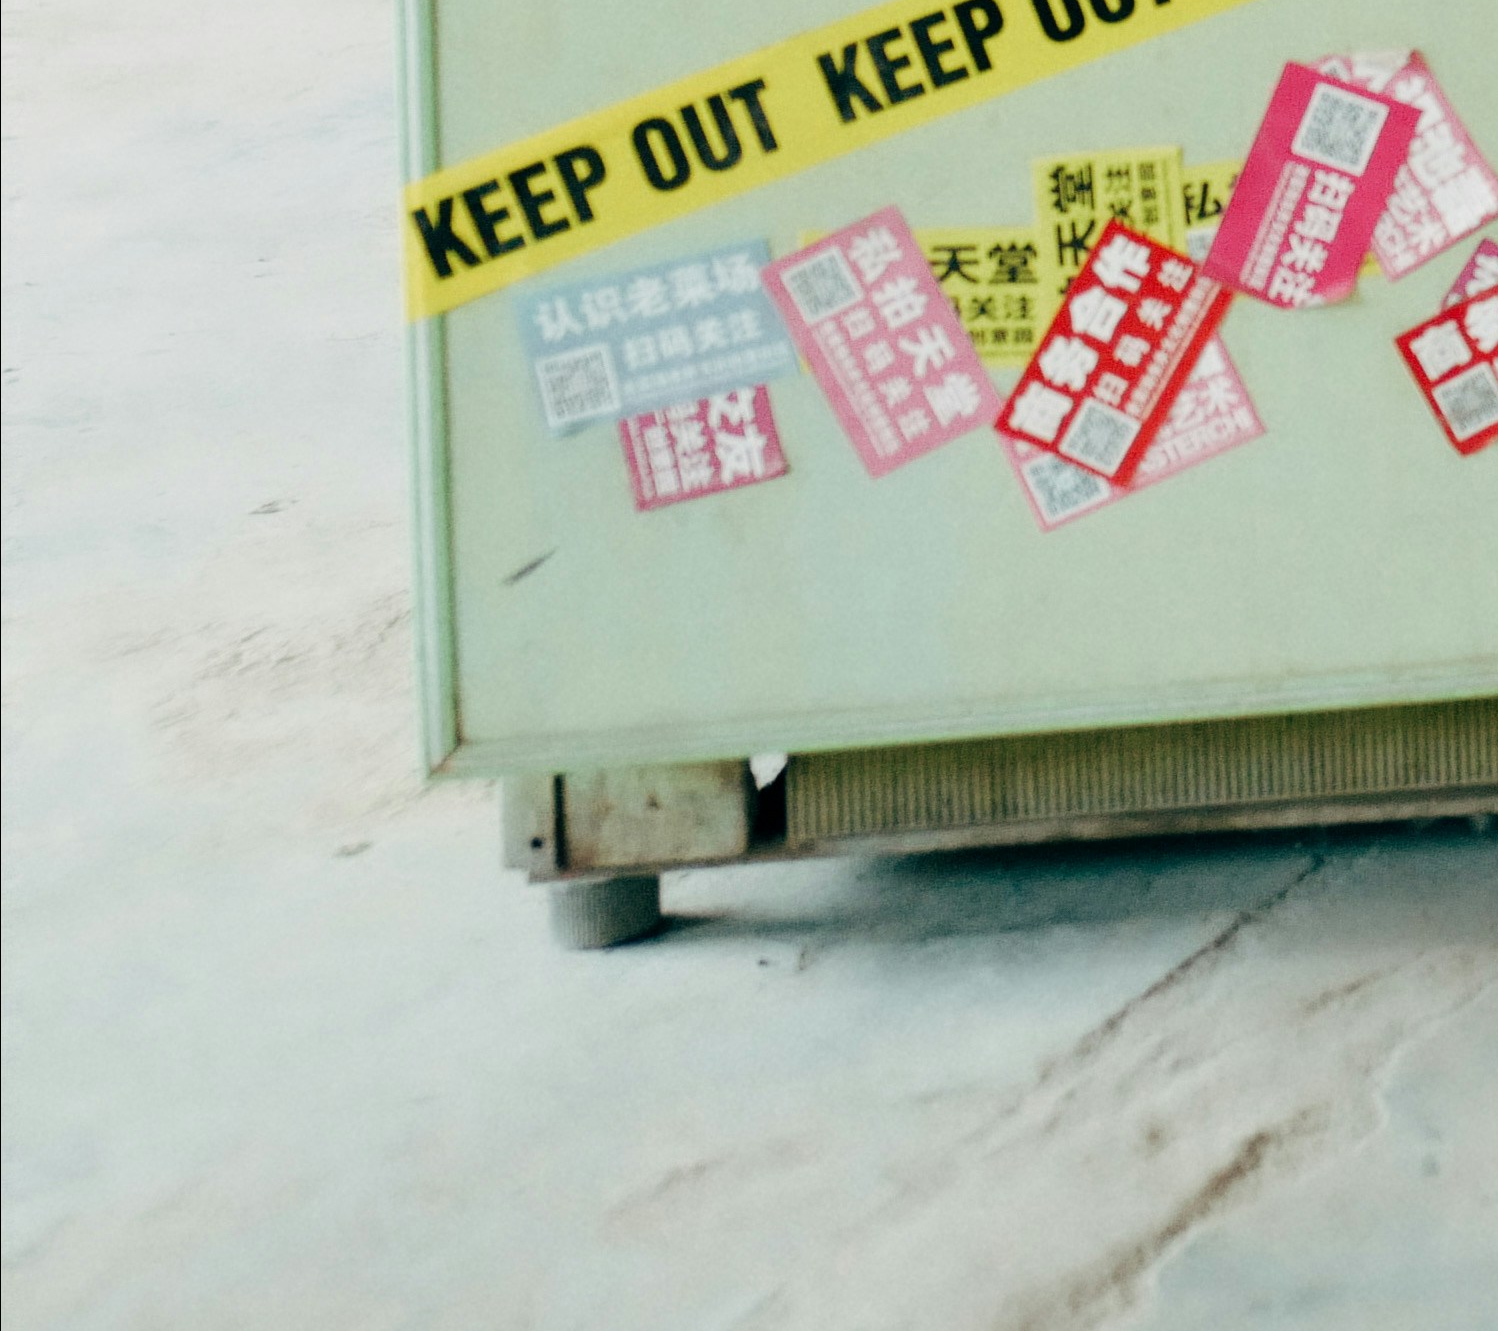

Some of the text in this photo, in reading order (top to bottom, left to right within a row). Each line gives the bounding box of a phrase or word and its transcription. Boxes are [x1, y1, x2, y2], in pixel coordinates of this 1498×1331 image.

[413, 142, 608, 280] KEEP
[627, 77, 780, 195] OUT
[1049, 161, 1096, 266] 天堂
[1266, 168, 1355, 308] 扫码关注
[847, 225, 983, 428] 私拍天堂
[929, 240, 1039, 286] 天堂
[1097, 258, 1196, 404] 扫码关注
[621, 309, 763, 372] 扫码关注
[838, 307, 932, 443] 扫码关注
[1008, 232, 1151, 443] 商务合作
[706, 386, 766, 485] 交友
